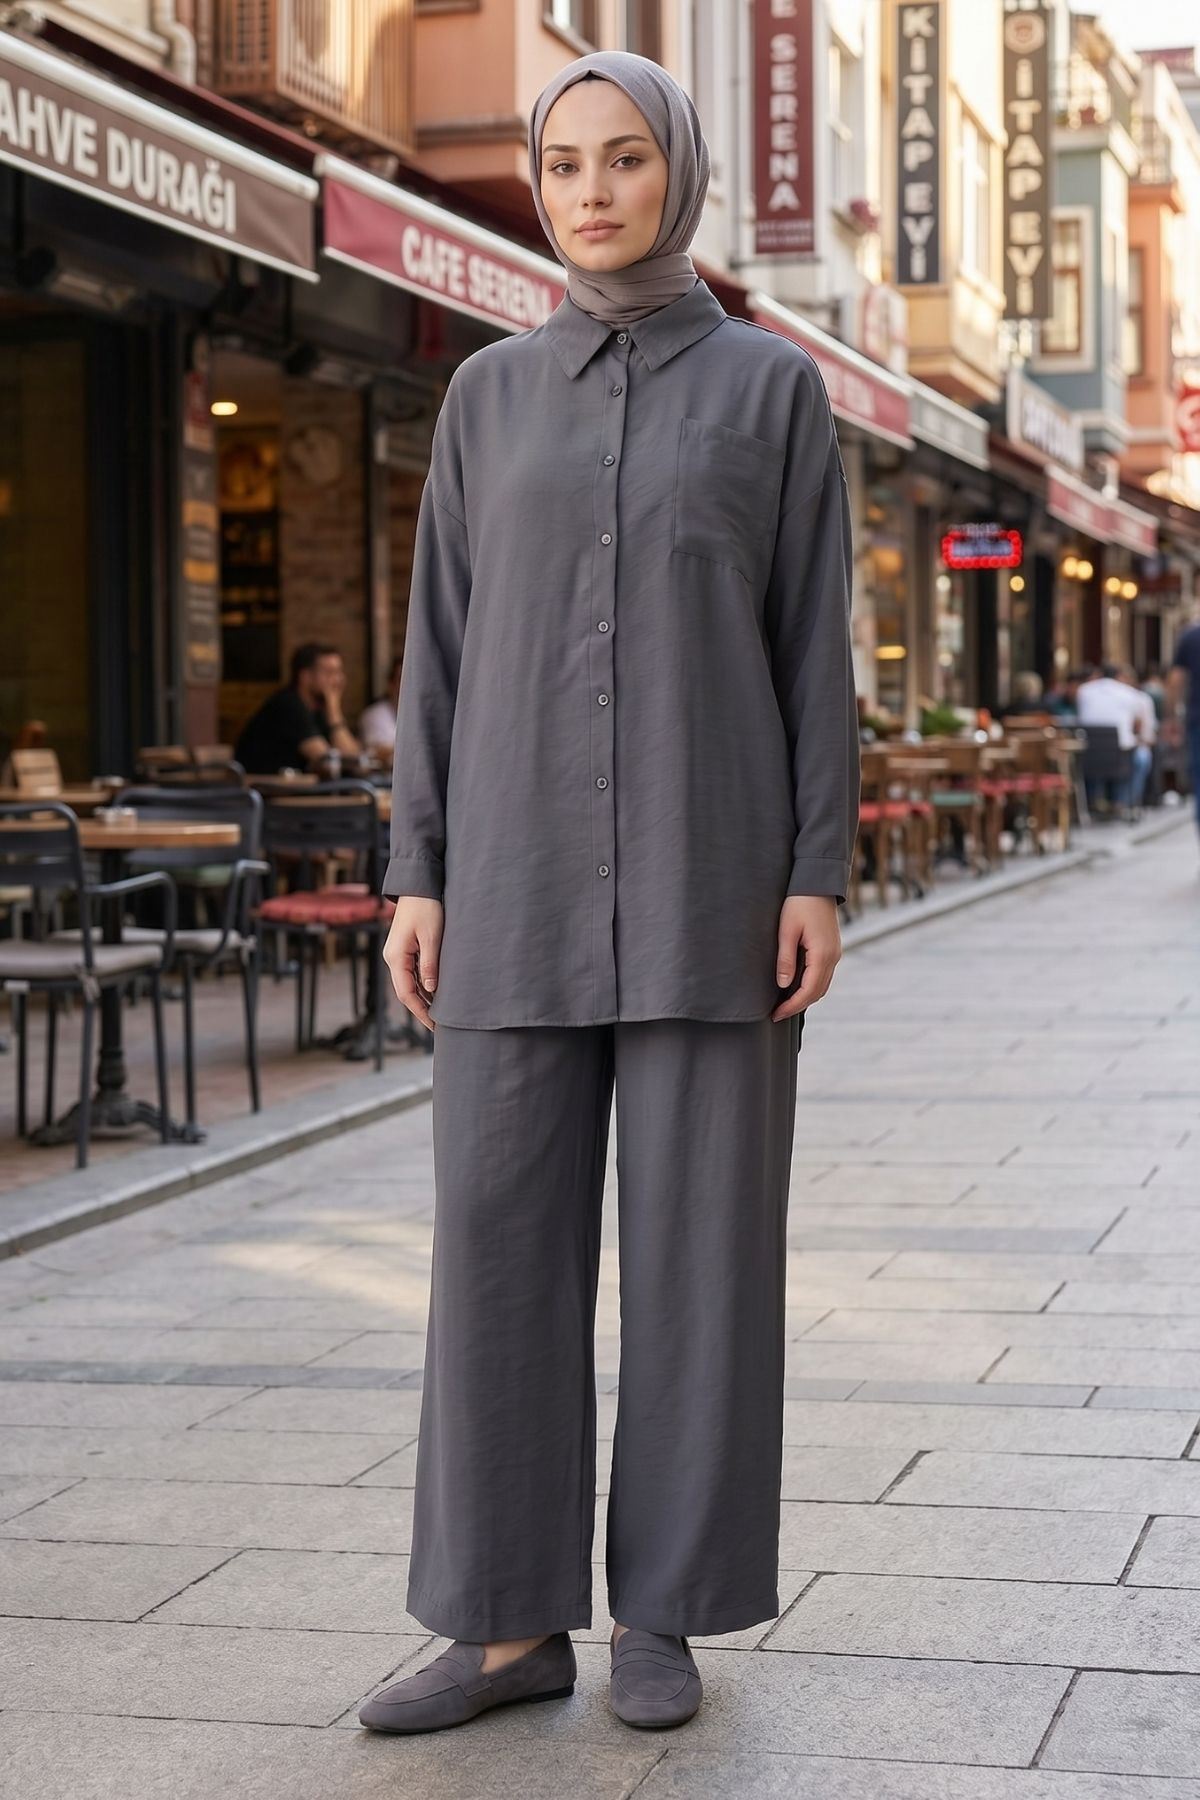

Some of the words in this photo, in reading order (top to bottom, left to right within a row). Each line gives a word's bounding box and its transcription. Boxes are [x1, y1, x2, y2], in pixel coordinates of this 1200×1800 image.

[767, 33, 800, 211] SERENA
[106, 125, 237, 234] DURAĞI
[402, 225, 467, 300] CAFE
